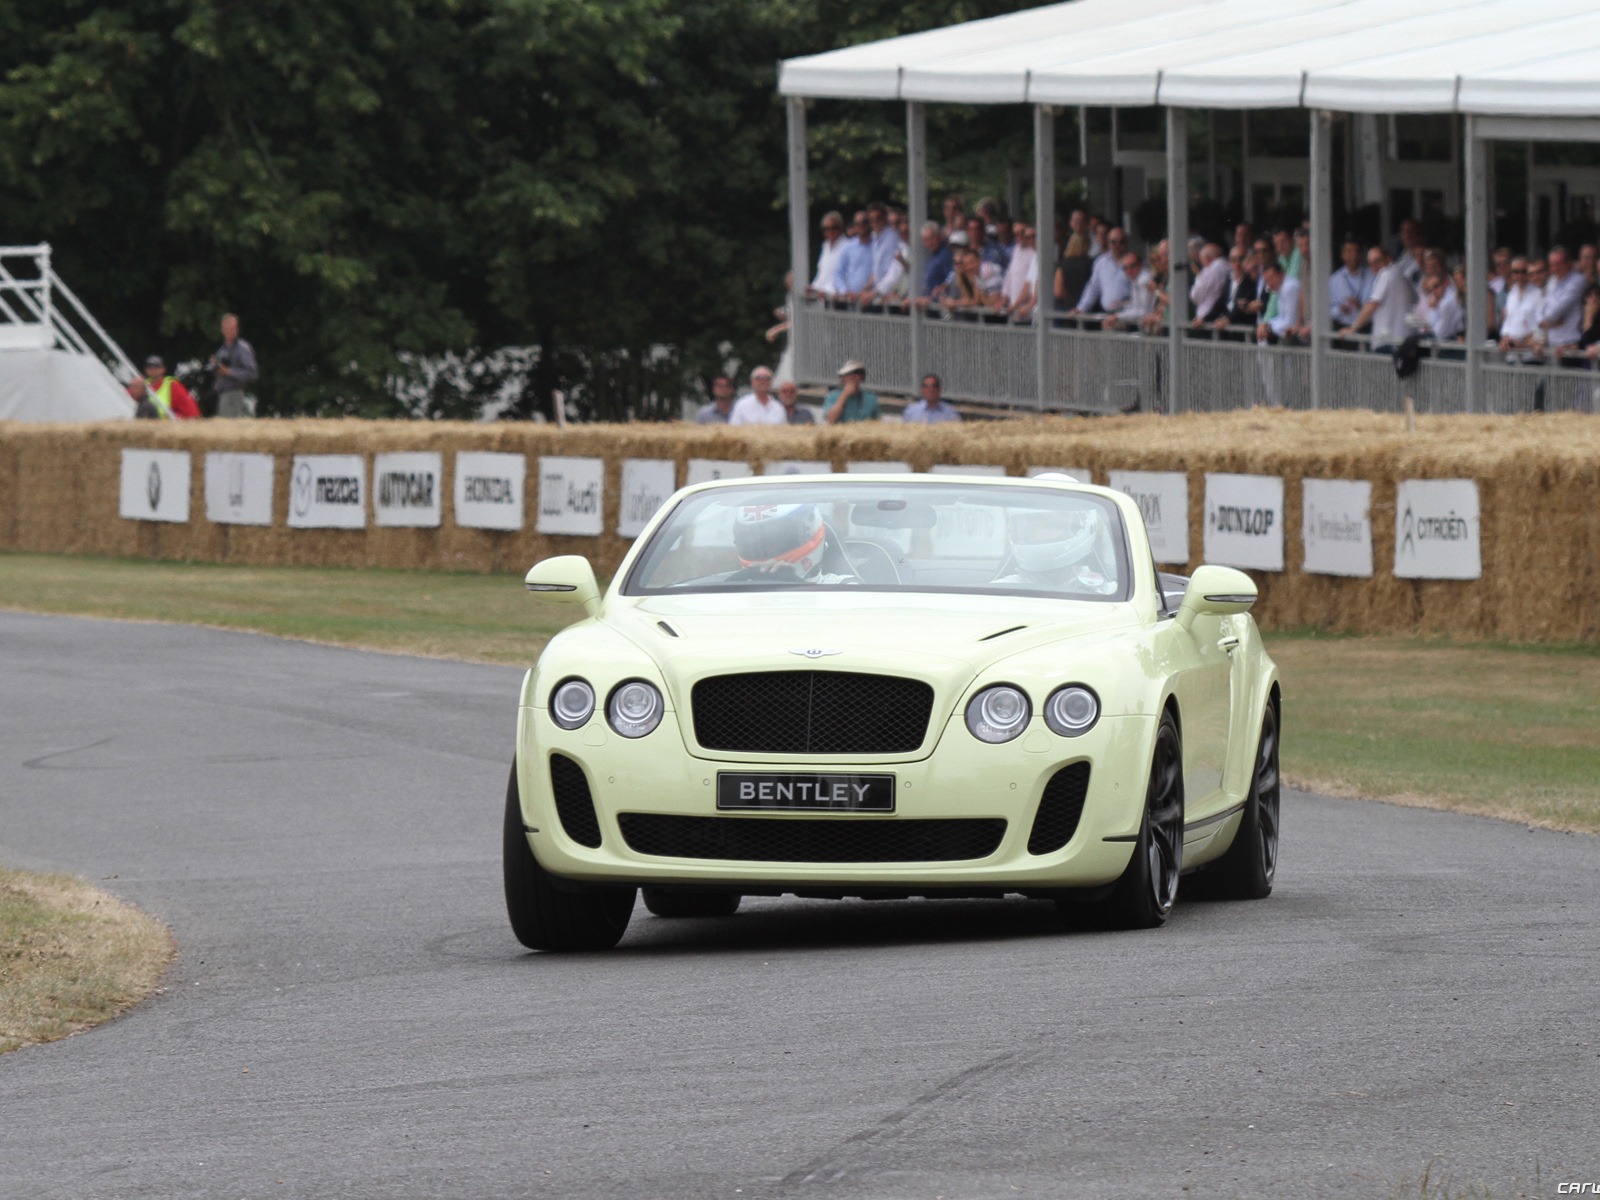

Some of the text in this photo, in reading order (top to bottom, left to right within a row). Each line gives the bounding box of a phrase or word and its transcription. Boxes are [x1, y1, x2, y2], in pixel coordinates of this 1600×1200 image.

[316, 477, 358, 504] mazda
[379, 472, 433, 507] AUTOCAR
[464, 475, 513, 504] HONDA
[567, 480, 598, 514] Audi
[1217, 505, 1274, 535] DUNLOP
[740, 782, 870, 802] BENTLEY
